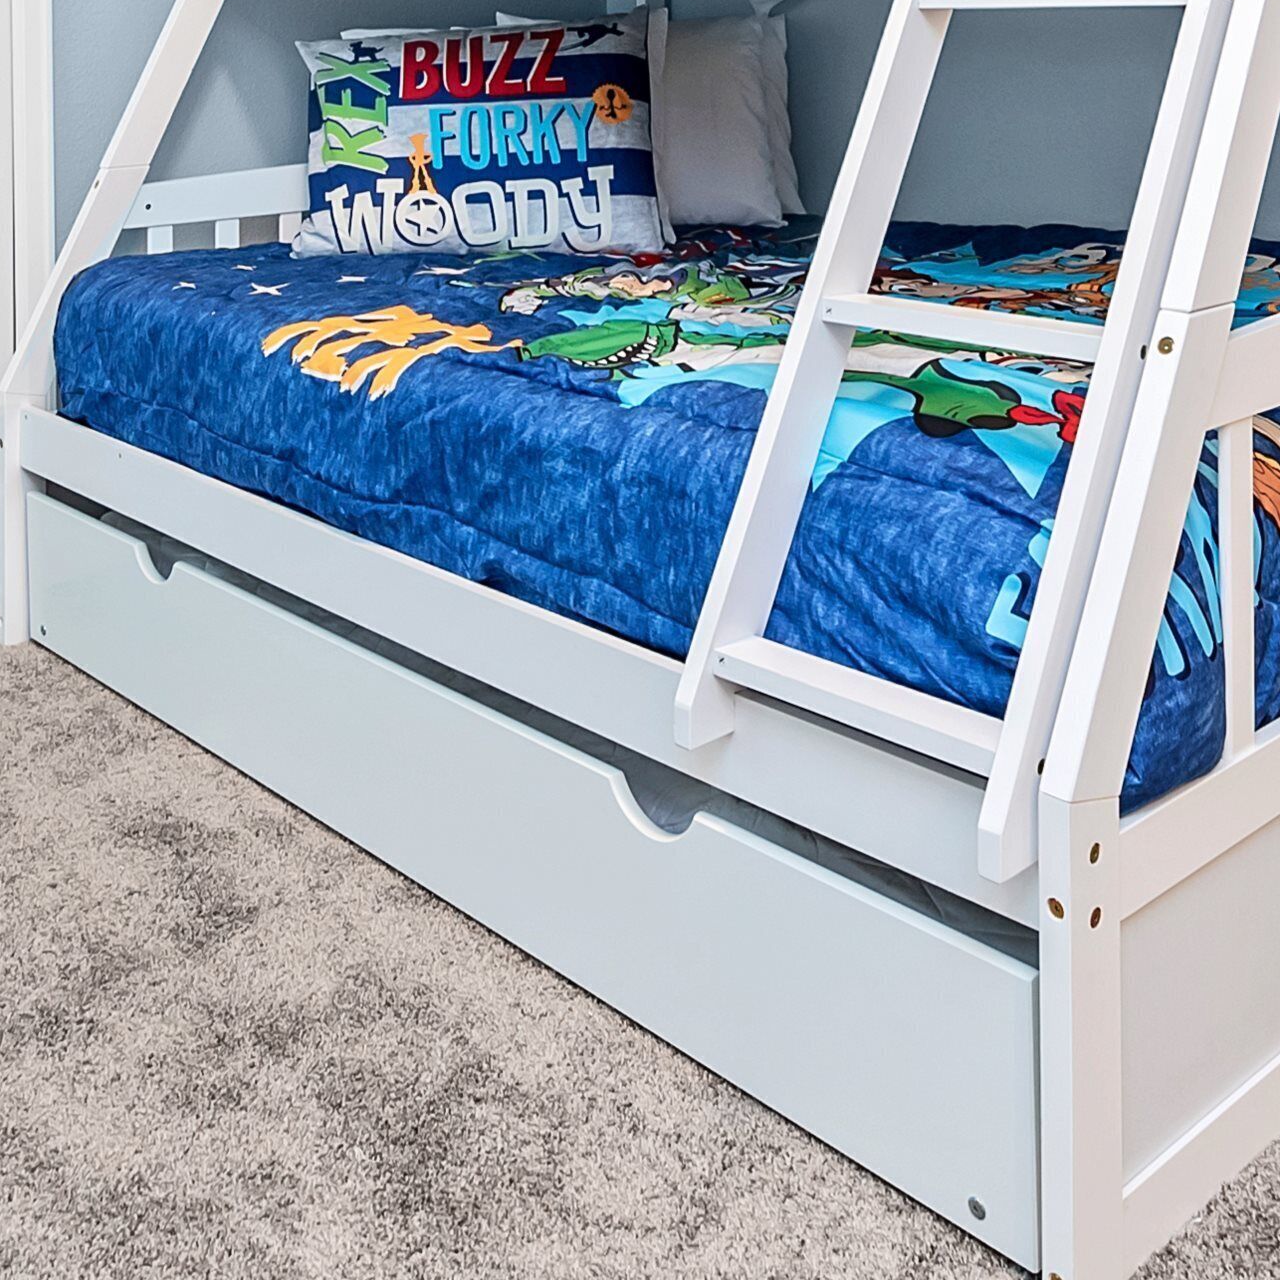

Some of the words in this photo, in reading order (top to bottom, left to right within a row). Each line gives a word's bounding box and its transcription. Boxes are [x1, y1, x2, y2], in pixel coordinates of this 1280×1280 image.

[399, 28, 567, 100] BUZZ
[314, 52, 392, 175] REX
[429, 102, 598, 170] FORKY
[325, 165, 614, 255] WOODY
